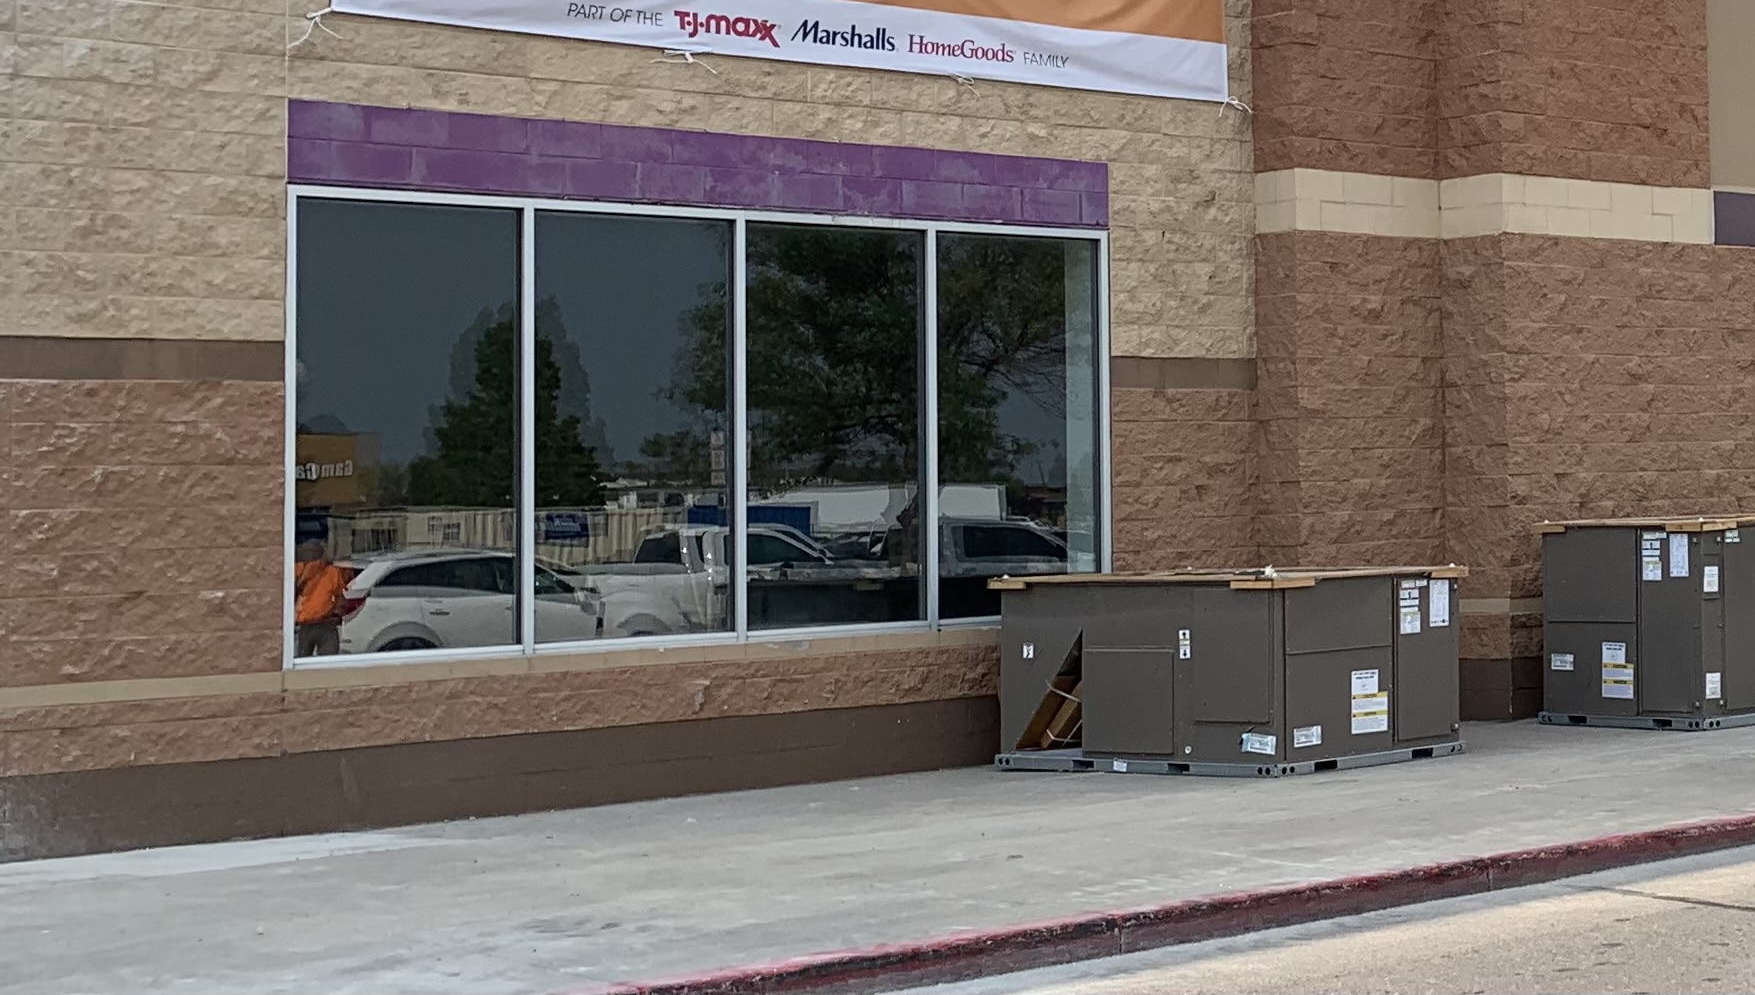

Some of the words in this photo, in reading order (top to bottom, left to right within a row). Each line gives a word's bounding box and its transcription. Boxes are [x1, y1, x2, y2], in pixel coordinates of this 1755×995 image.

[567, 2, 606, 20] PART
[610, 7, 633, 24] OF
[636, 12, 664, 27] THE
[791, 19, 895, 52] Marshalls
[907, 33, 1015, 63] HomeGoods
[1023, 51, 1070, 69] FAMILY
